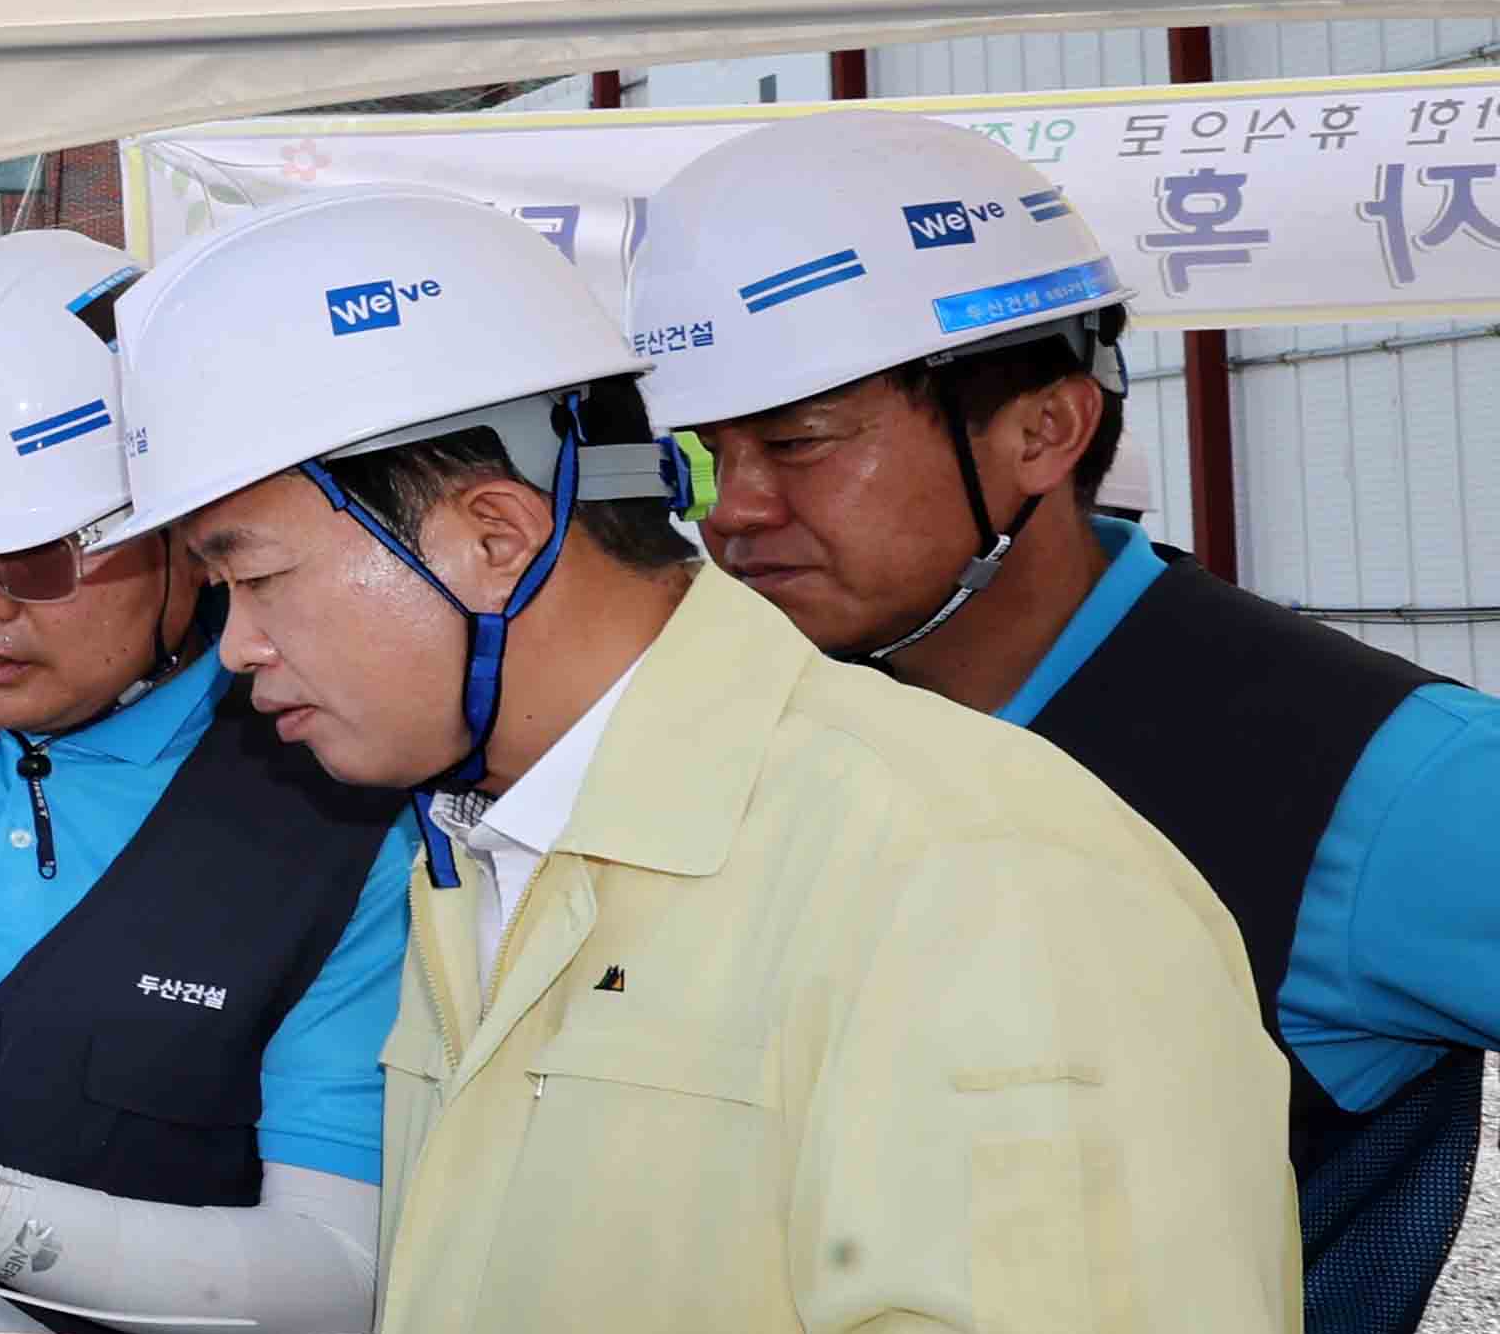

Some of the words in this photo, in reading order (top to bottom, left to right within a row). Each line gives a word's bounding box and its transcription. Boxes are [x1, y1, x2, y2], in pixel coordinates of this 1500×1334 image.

[901, 197, 1006, 250] We've
[326, 276, 444, 335] We've
[135, 973, 228, 1011] 두산건설
